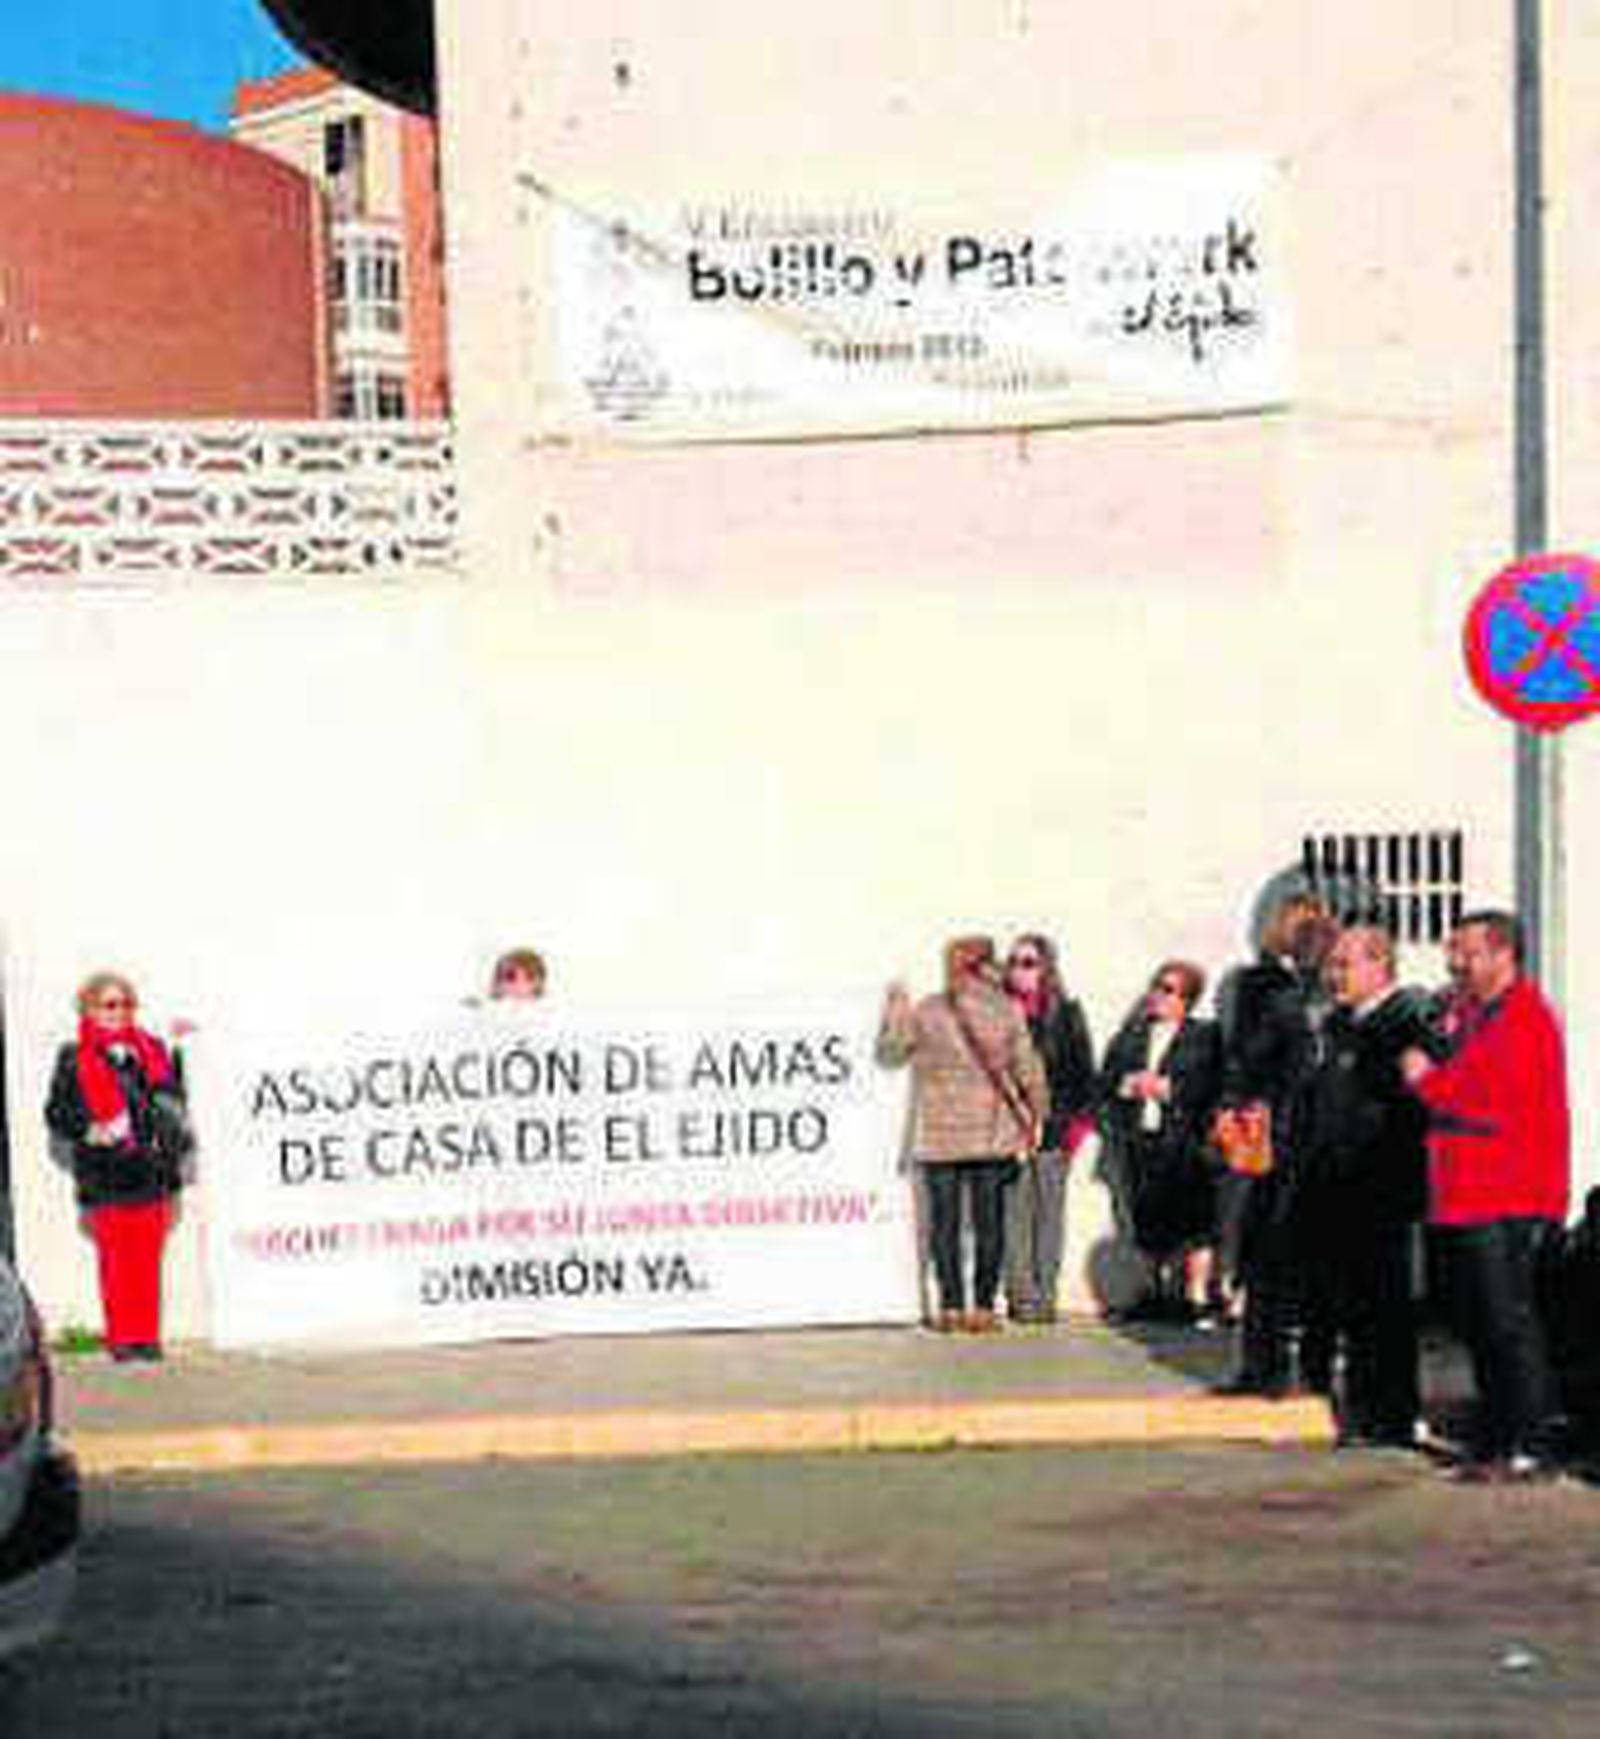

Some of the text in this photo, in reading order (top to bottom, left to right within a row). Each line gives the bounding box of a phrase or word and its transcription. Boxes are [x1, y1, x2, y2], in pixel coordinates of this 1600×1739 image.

[894, 254, 923, 307] y
[252, 1035, 850, 1116] ASOCIACIÓN DE AMAS
[279, 1104, 829, 1185] DE CASA DE EL EJIDO
[420, 1250, 624, 1304] DIMISIÓN
